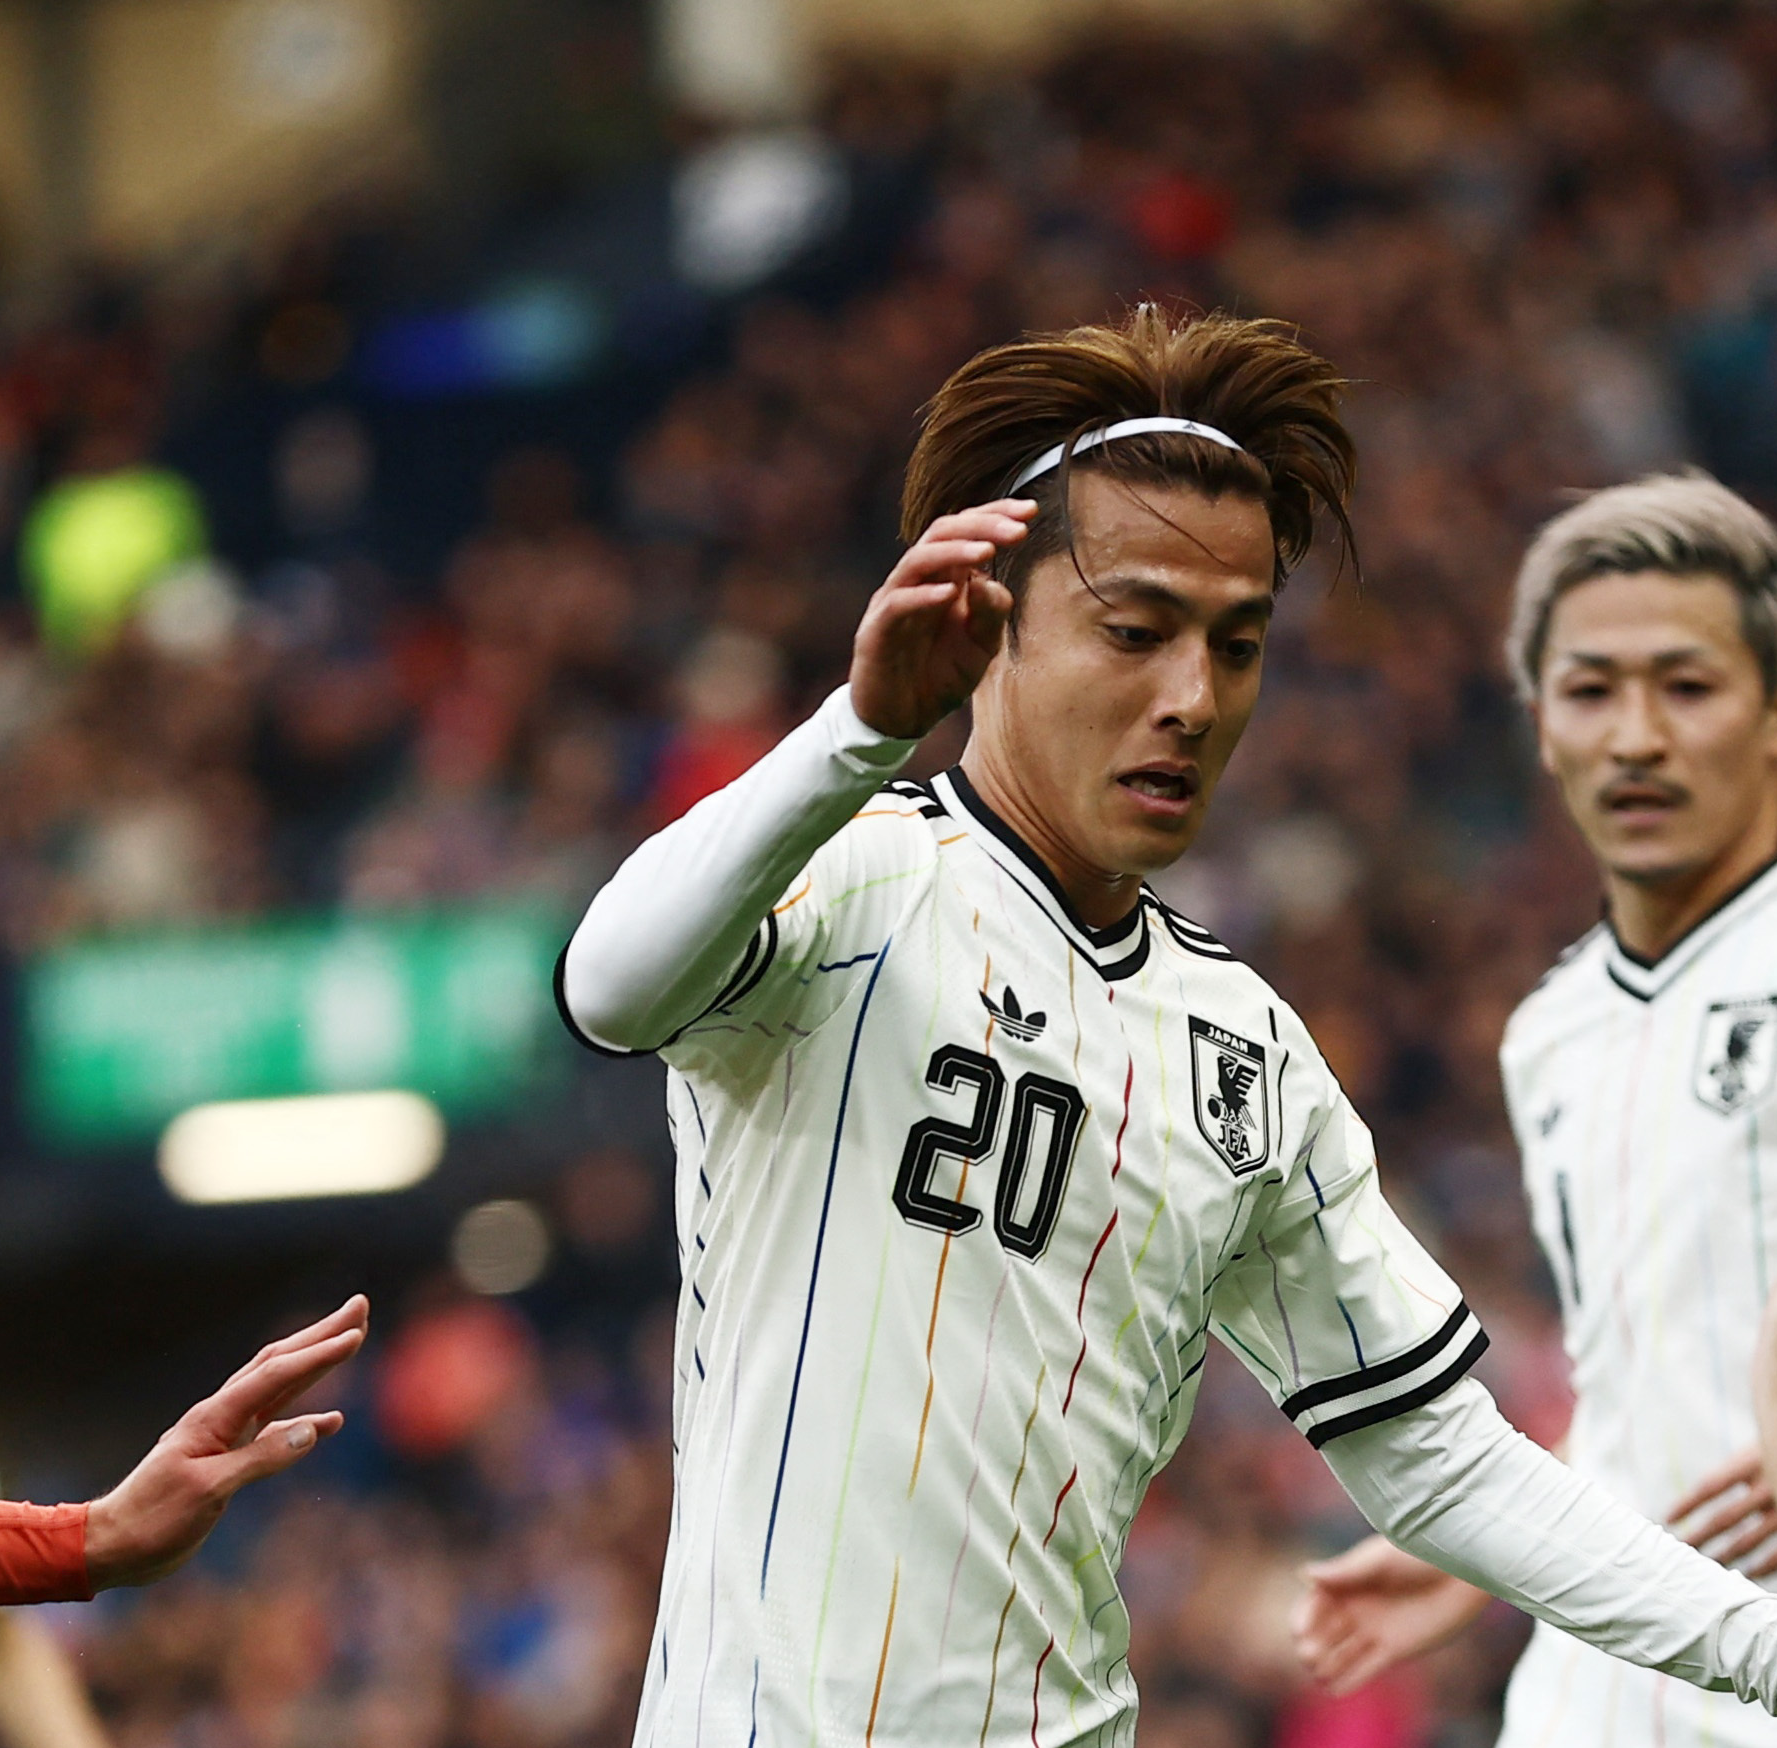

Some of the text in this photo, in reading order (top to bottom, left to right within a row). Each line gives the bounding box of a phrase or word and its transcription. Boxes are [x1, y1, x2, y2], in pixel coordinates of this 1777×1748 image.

[1207, 1026, 1250, 1054] JAPAN
[891, 1043, 1091, 1265] 20
[1218, 1124, 1253, 1158] JFA
